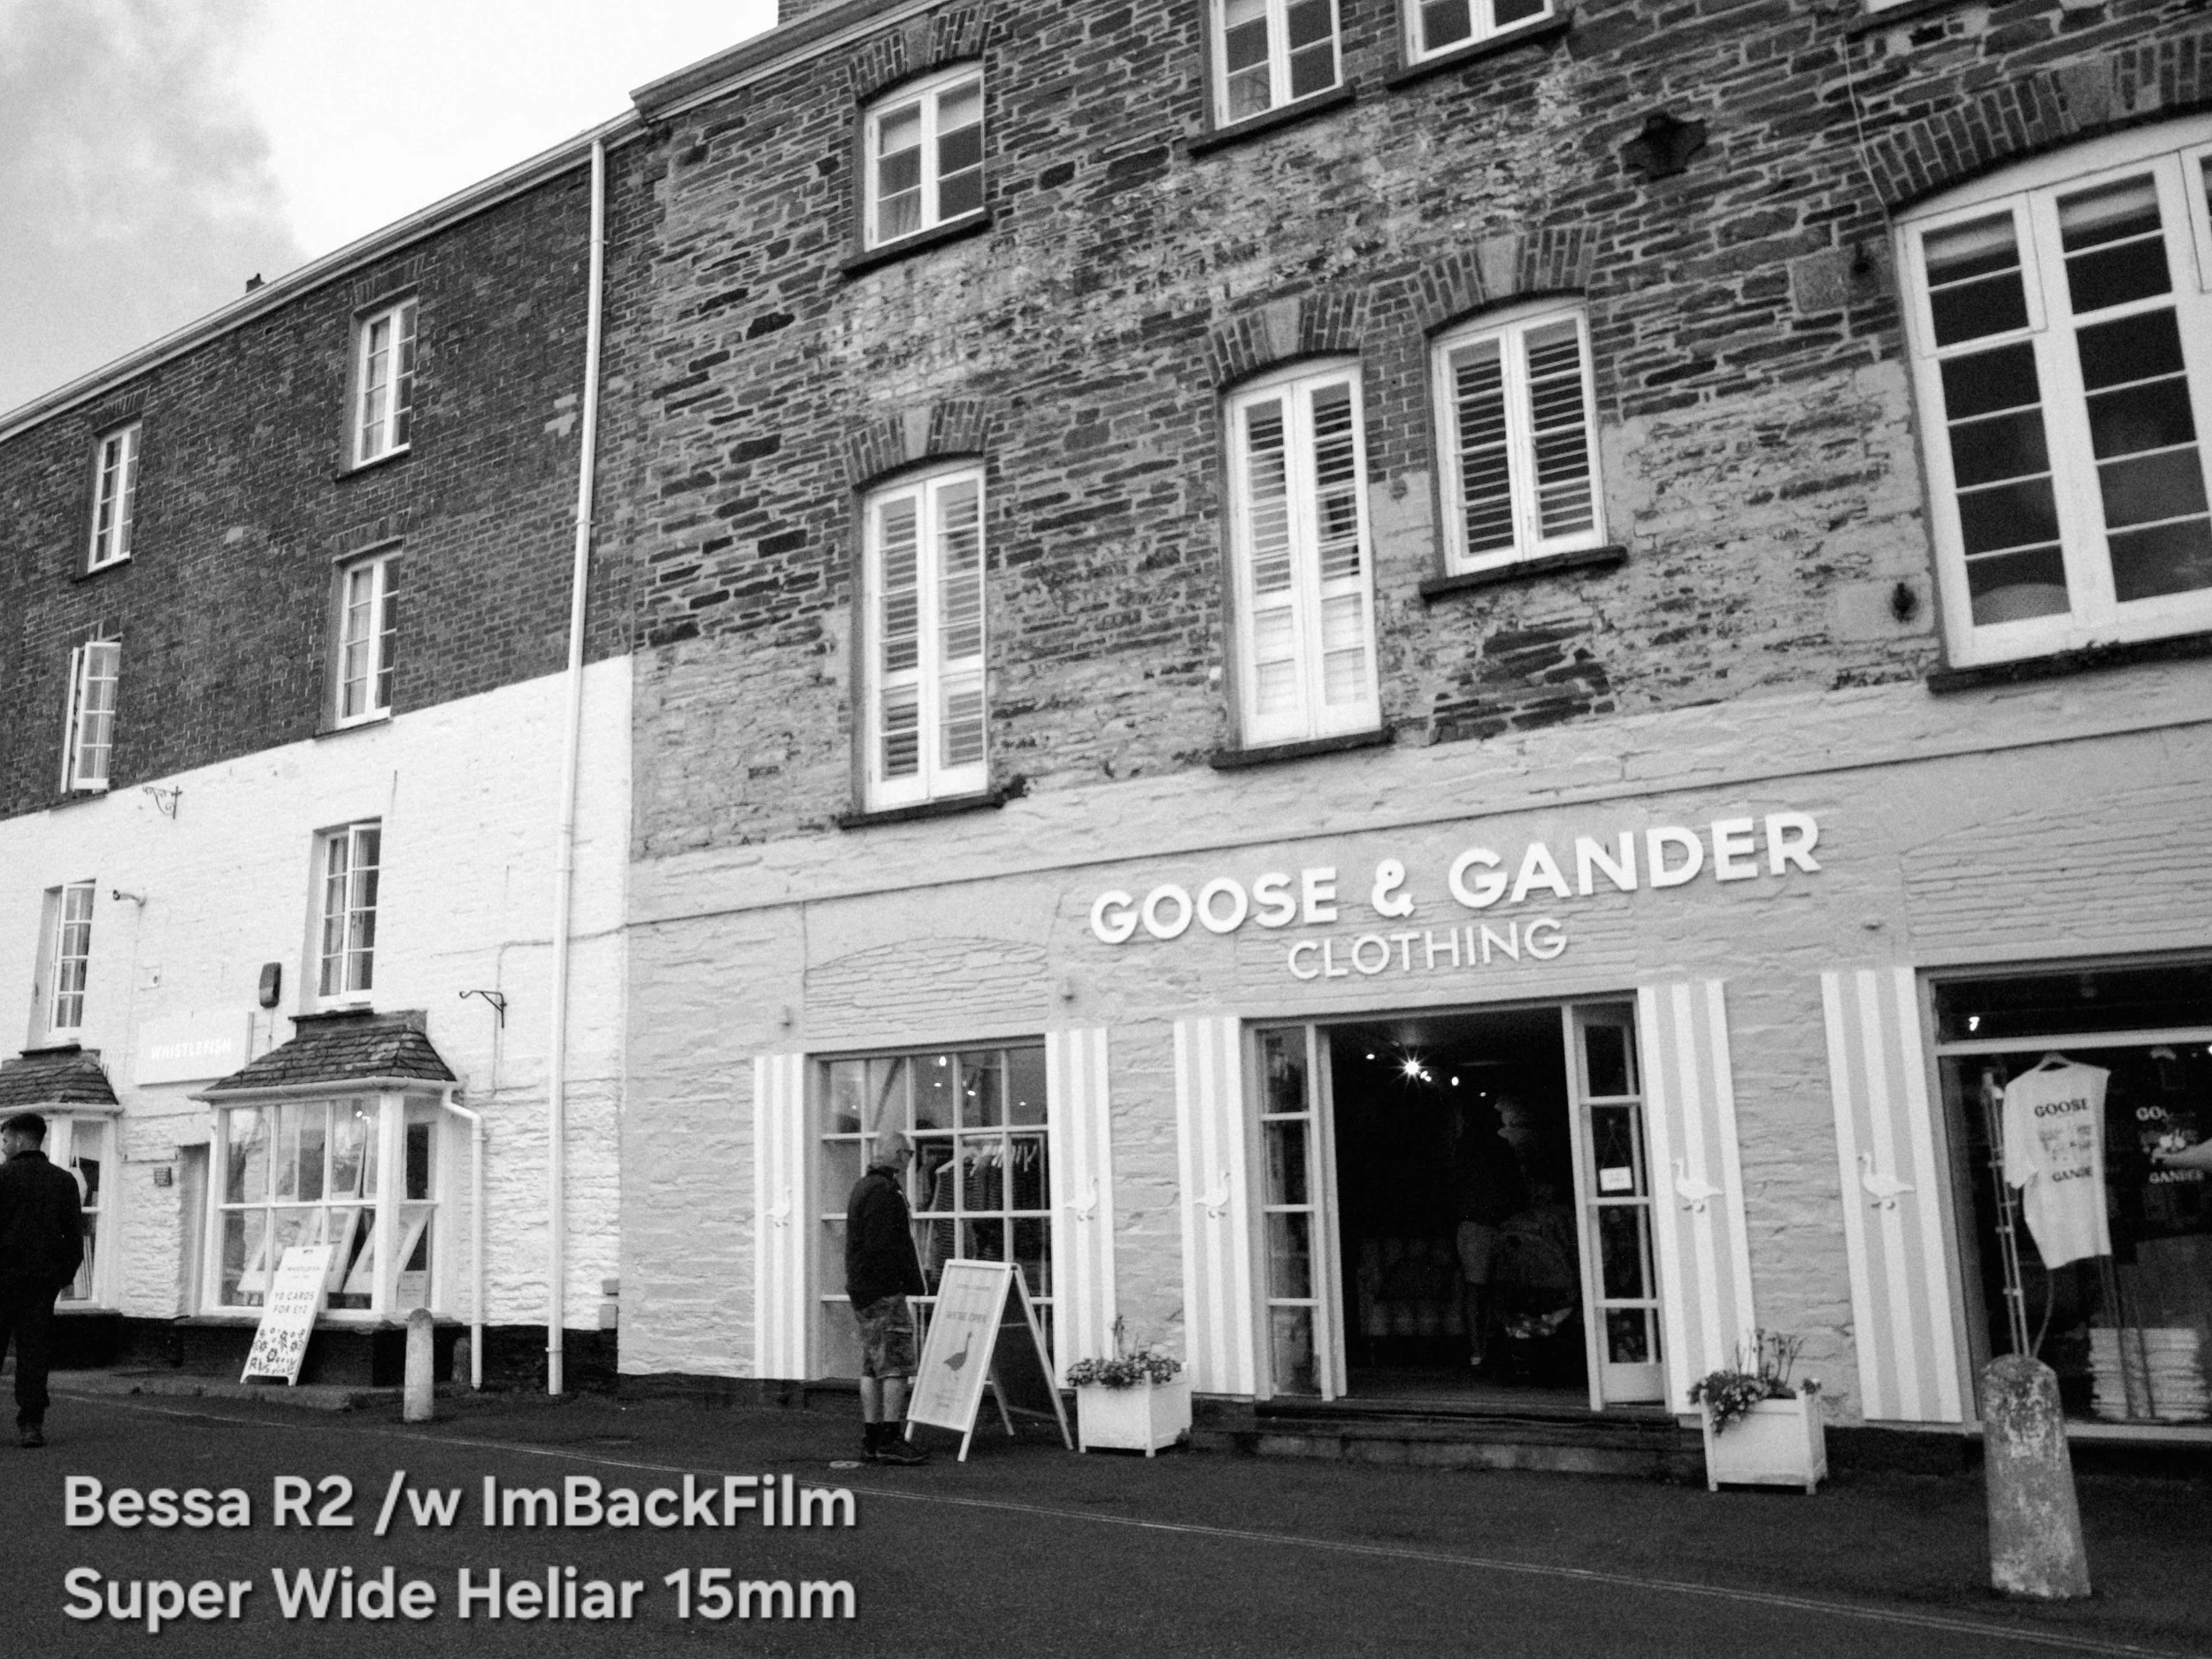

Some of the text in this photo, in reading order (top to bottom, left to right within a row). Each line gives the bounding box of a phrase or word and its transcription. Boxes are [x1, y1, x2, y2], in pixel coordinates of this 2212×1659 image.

[1090, 811, 1821, 944] GOOSE & GANDER
[1287, 918, 1567, 979] CLOTHING
[151, 1037, 232, 1060] WHISTLEFISH
[2035, 1097, 2087, 1118] GOOSE
